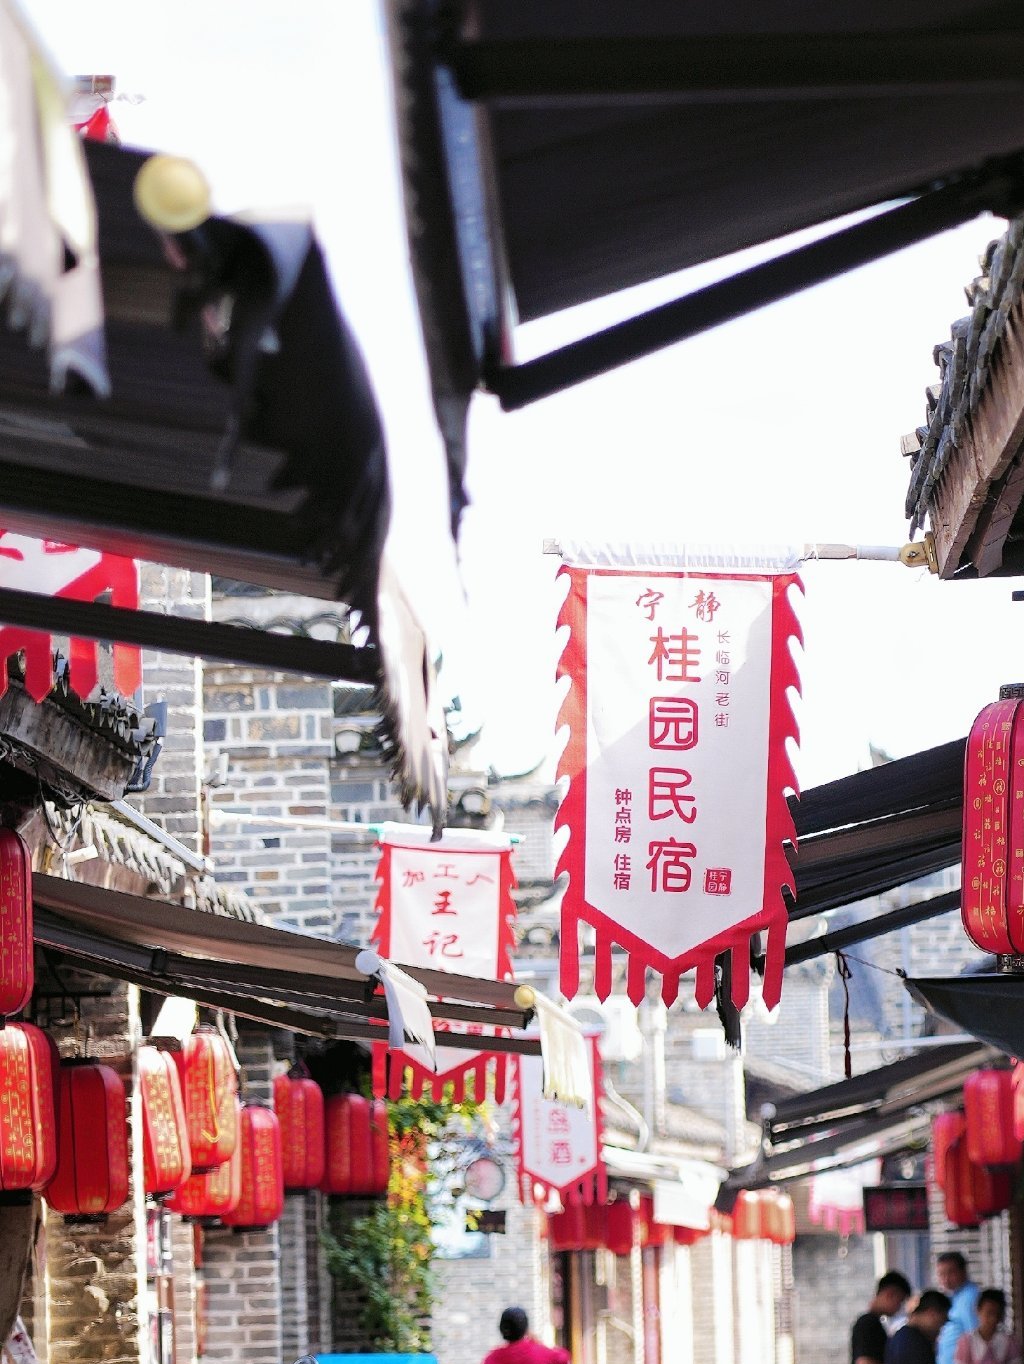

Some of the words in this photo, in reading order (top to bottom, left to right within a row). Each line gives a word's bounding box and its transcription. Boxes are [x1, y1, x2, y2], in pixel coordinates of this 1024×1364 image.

[635, 588, 721, 623] 宁静
[714, 629, 731, 728] 长临河老街
[645, 626, 702, 893] 桂园民宿
[614, 788, 632, 843] 钟点房
[613, 853, 632, 890] 住宿
